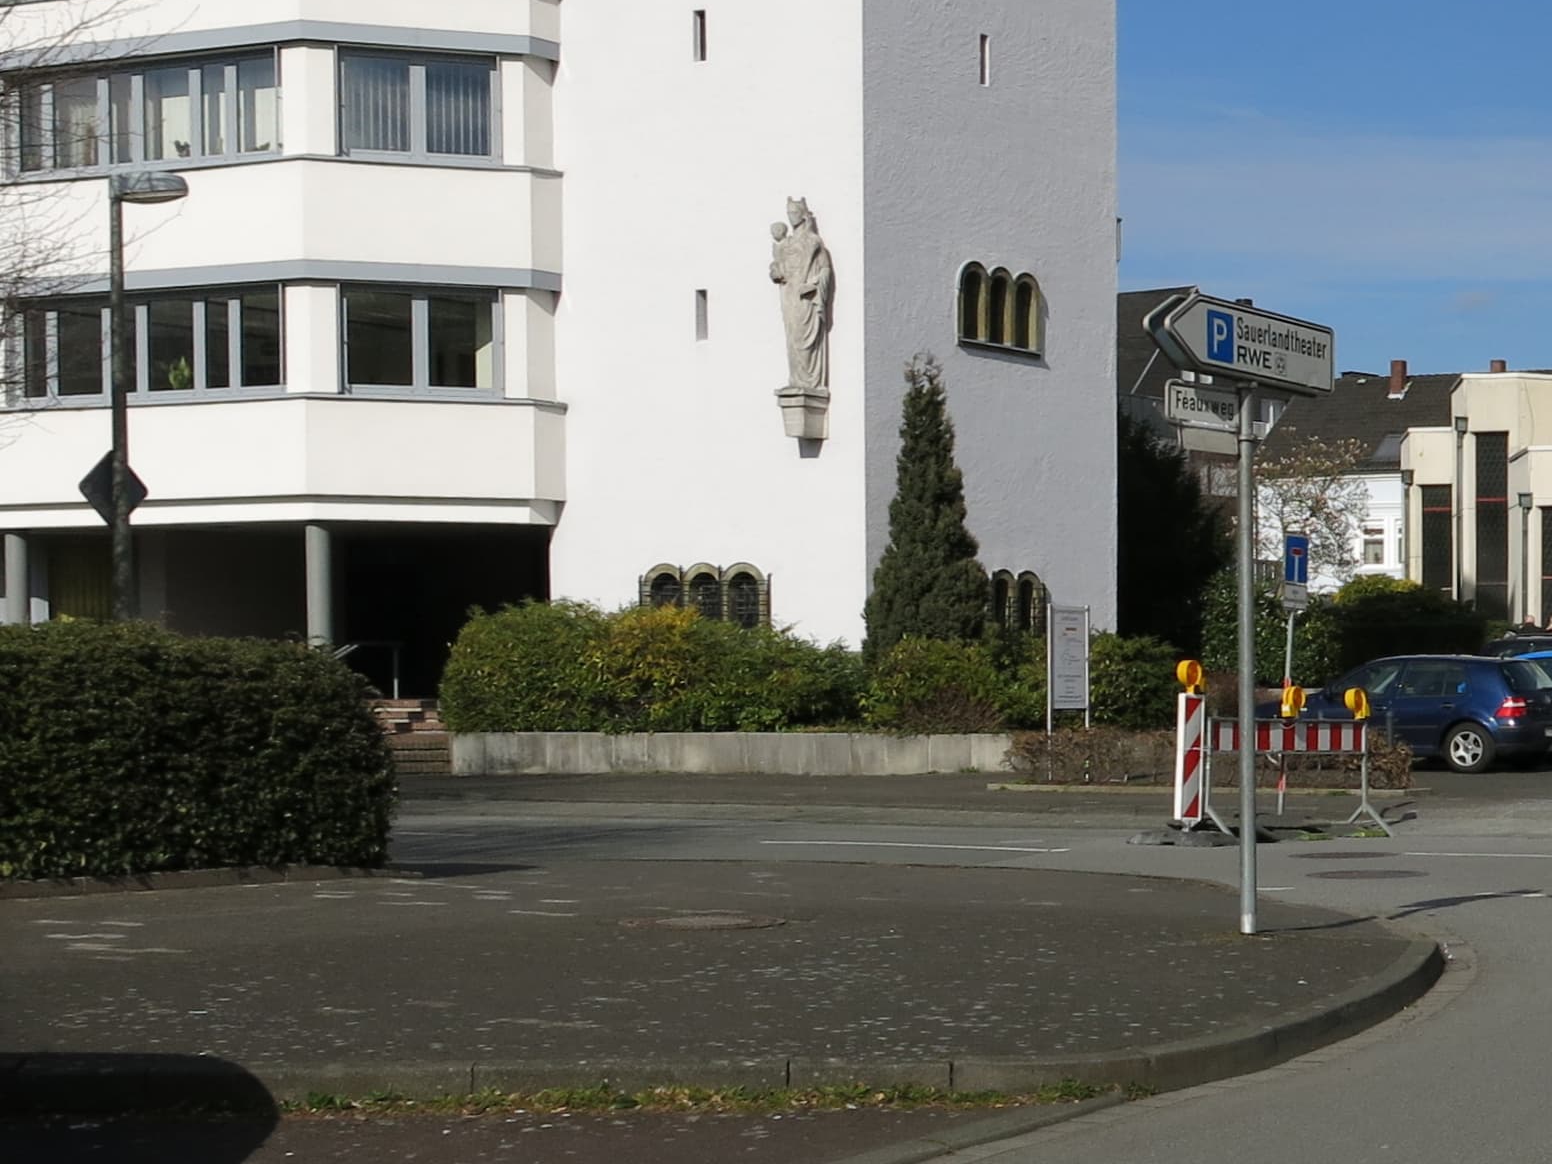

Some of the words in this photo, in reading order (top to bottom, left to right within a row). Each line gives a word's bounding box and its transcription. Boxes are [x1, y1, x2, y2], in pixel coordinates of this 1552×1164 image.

[1212, 317, 1228, 354] P
[1236, 316, 1328, 360] Sauerlandtheater
[1236, 344, 1273, 370] RWE
